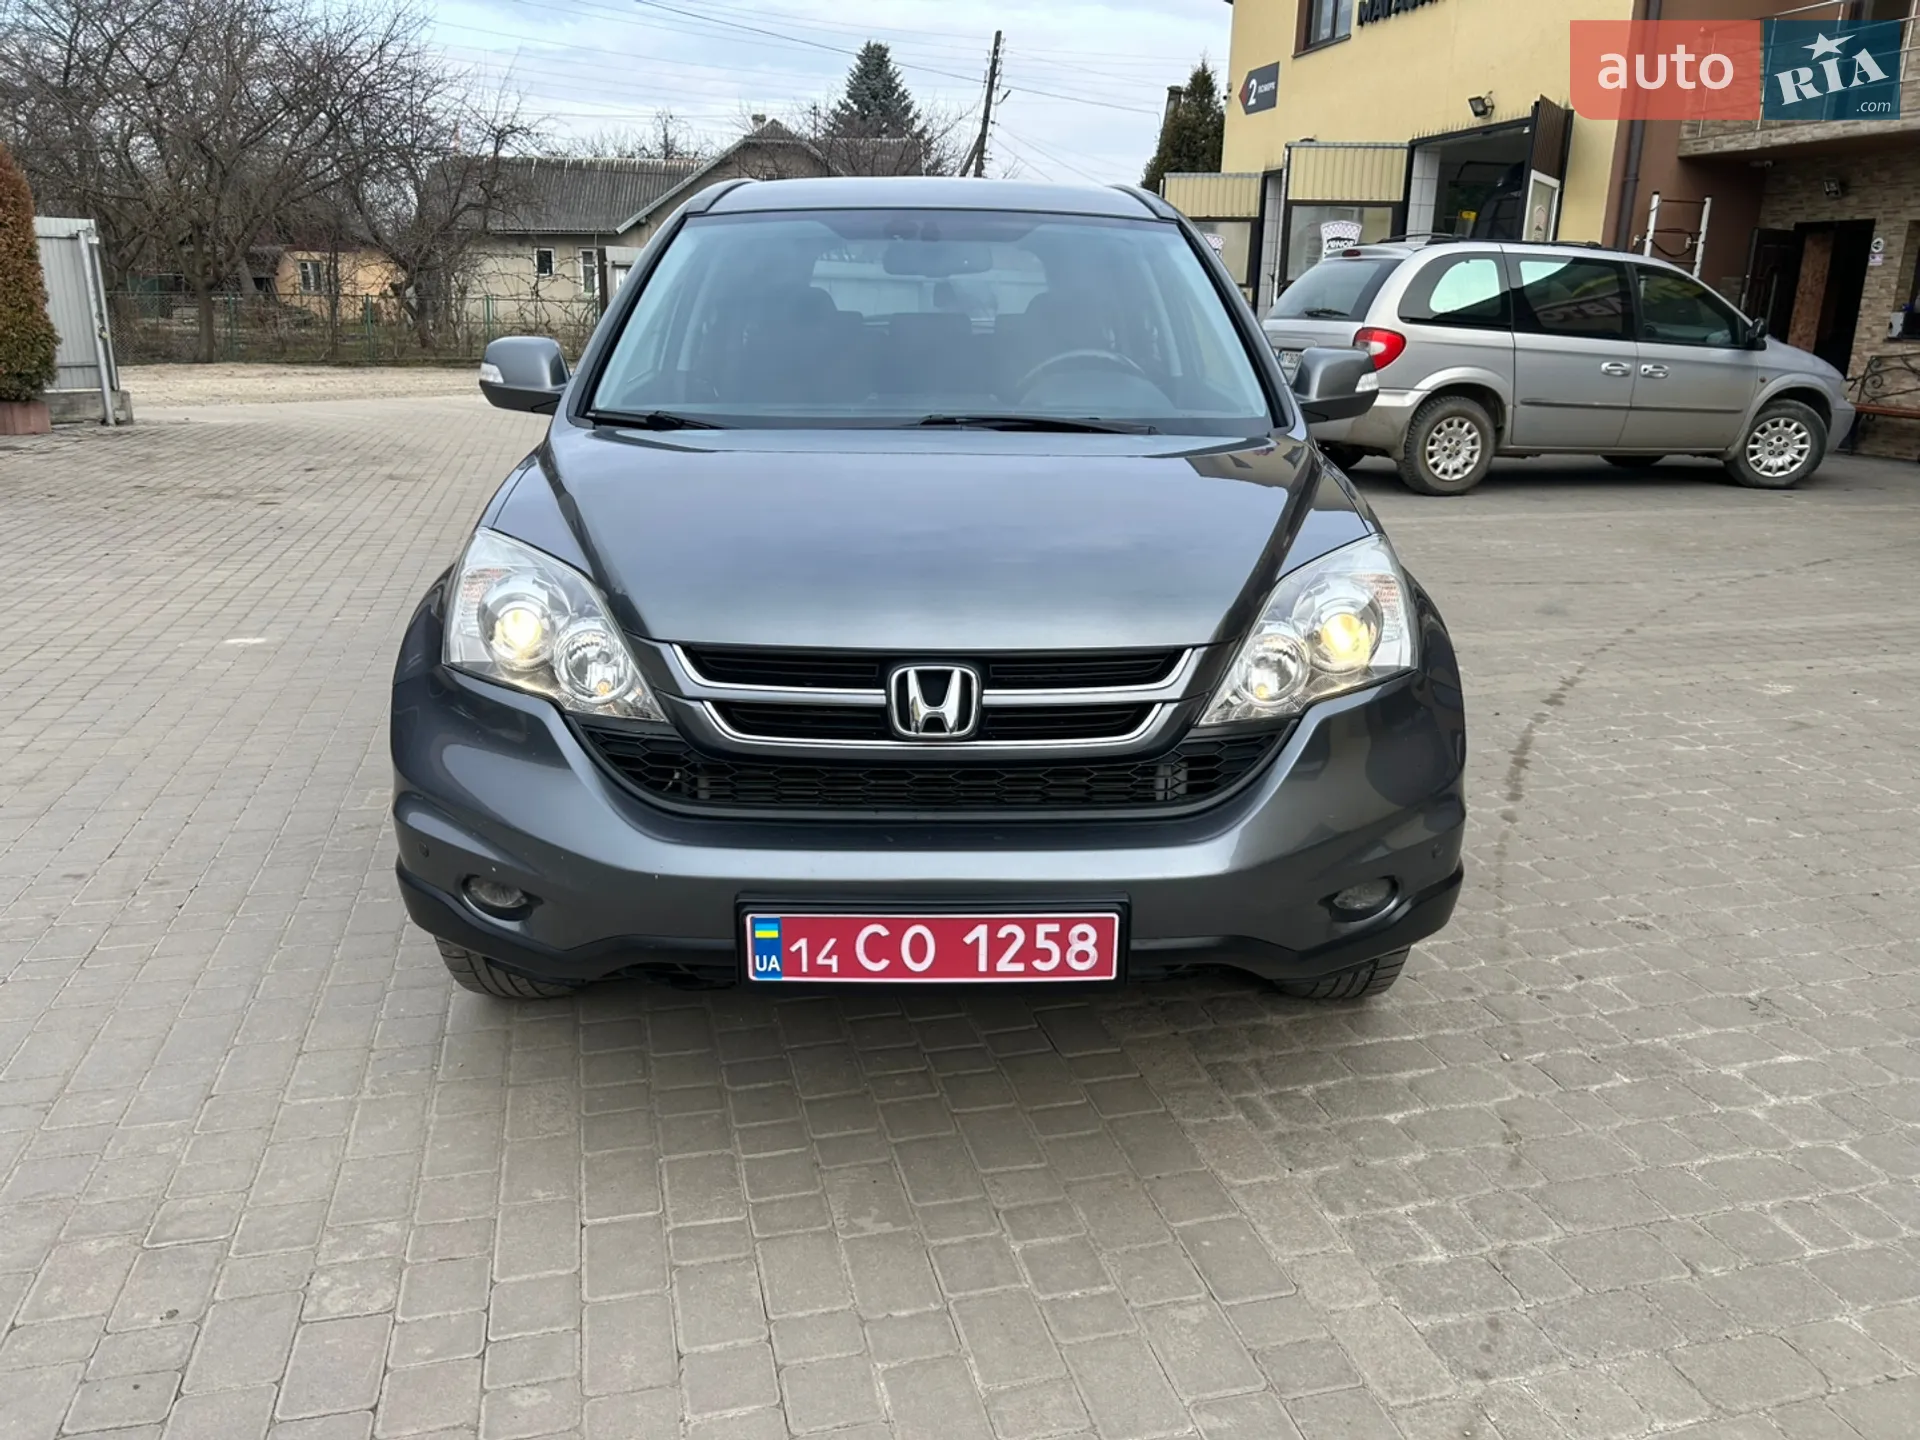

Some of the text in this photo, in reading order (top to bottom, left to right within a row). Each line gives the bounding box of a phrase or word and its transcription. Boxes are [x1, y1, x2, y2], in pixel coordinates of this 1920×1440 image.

[1247, 78, 1257, 106] 2
[789, 923, 1099, 973] 14 CO 1258
[756, 954, 780, 972] UA
